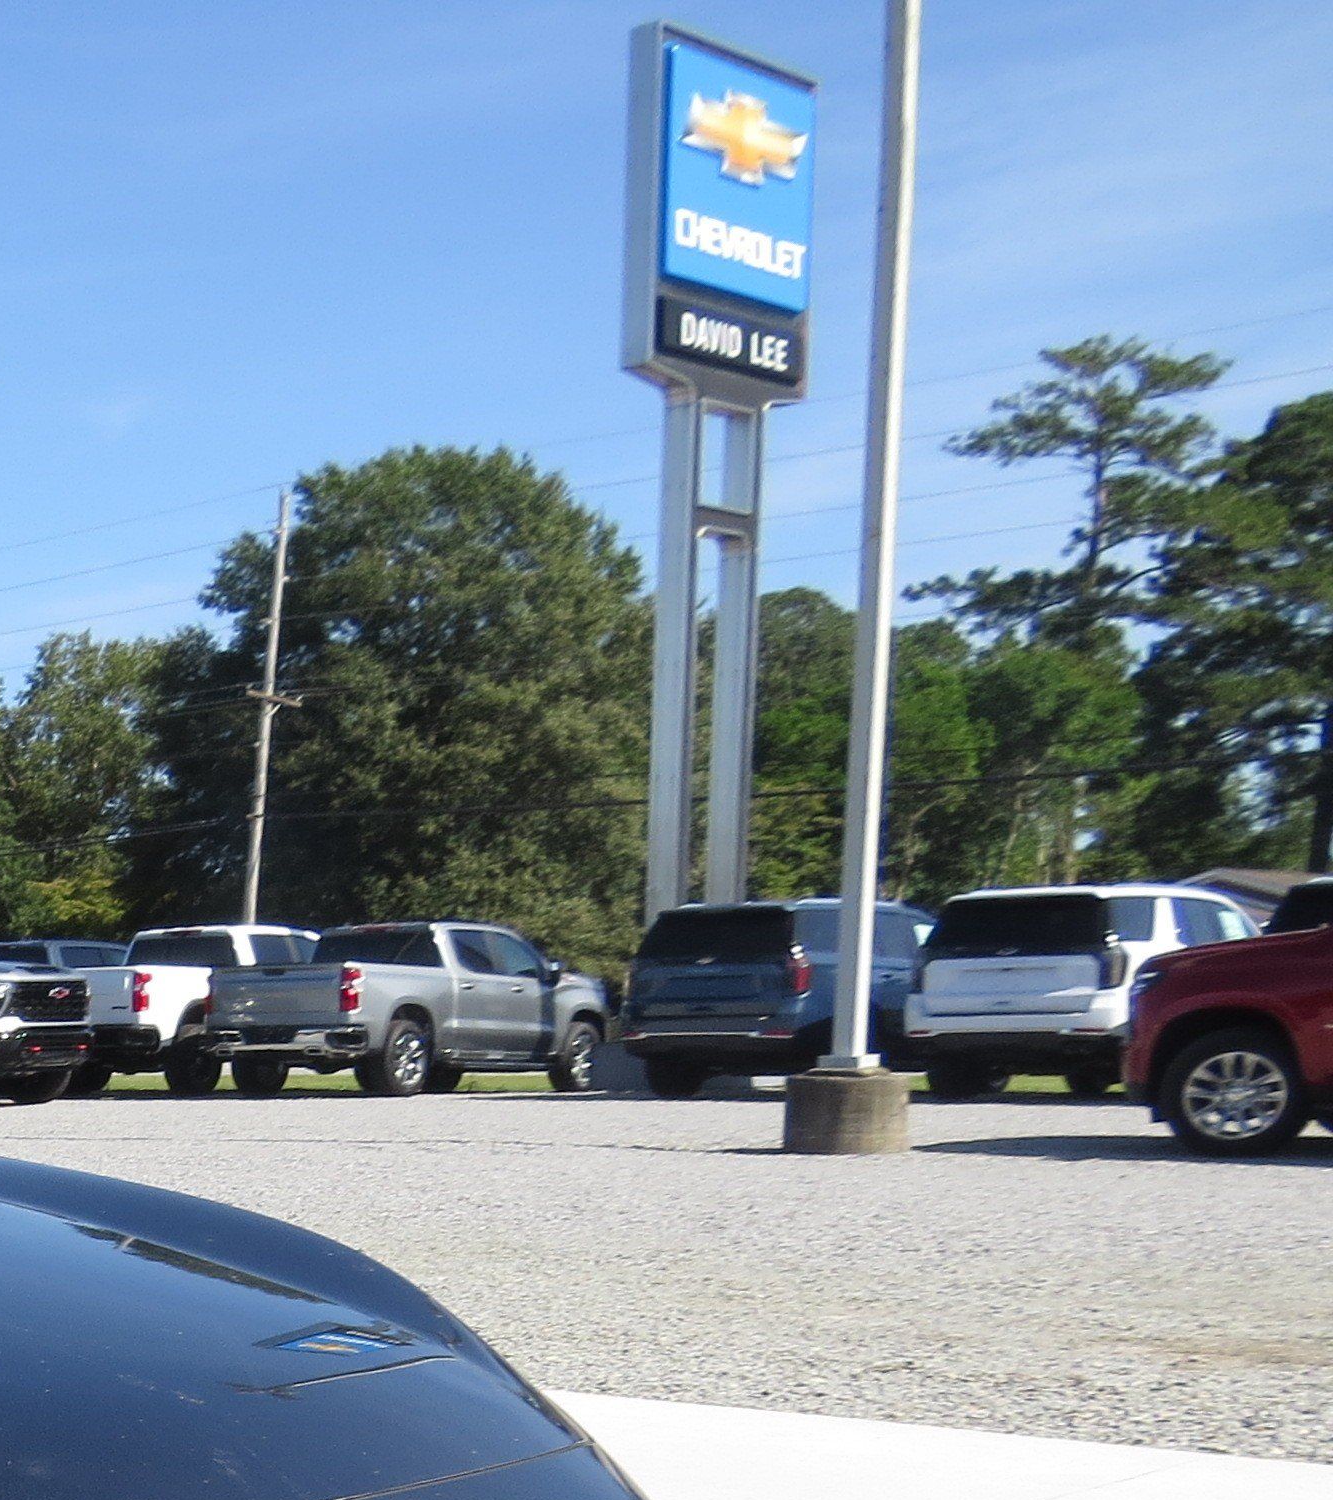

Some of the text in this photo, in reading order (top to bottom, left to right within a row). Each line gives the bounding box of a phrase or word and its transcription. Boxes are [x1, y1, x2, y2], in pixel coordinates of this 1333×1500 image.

[675, 208, 806, 279] CHEVROLET
[681, 312, 789, 372] DAVID LEE
